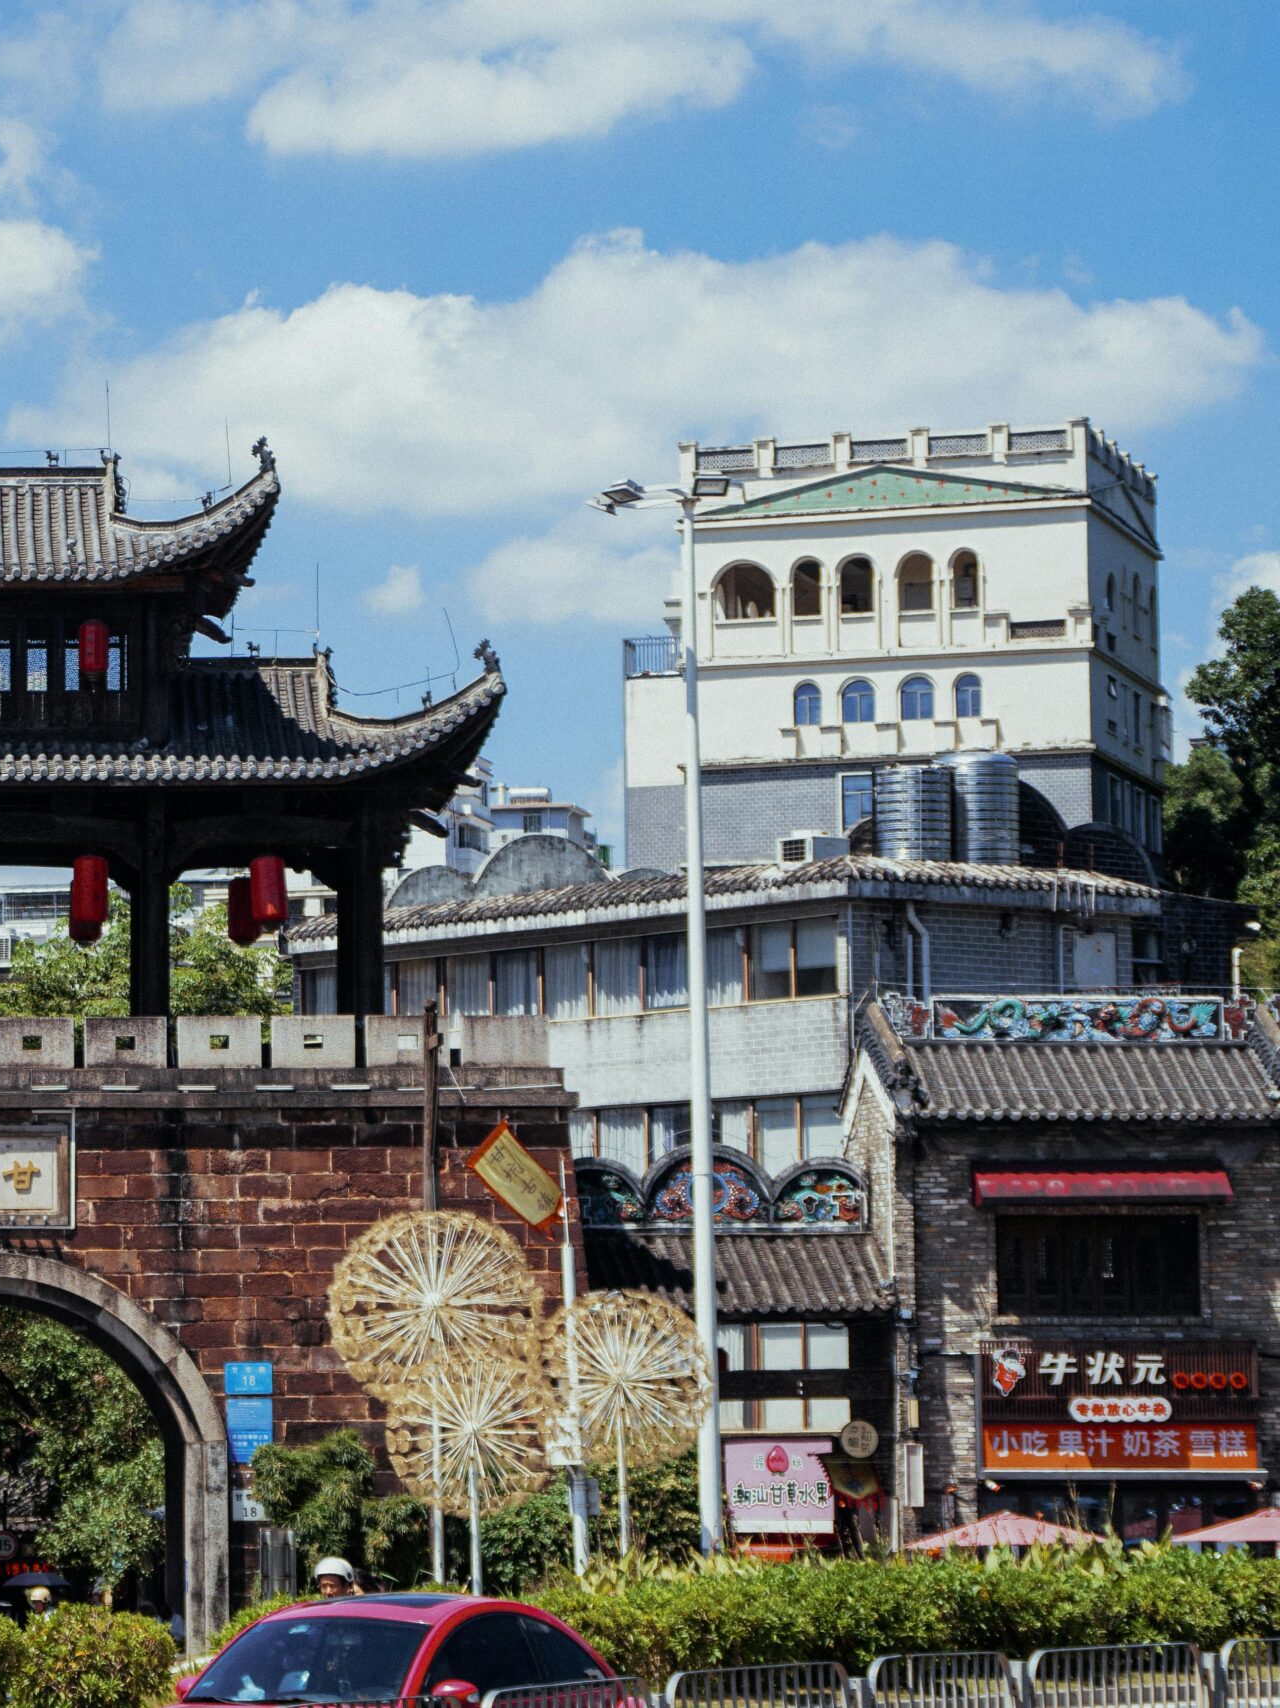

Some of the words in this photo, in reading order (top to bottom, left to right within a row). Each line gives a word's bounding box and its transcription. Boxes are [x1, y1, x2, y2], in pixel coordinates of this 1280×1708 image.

[241, 1375, 257, 1387] 18
[1038, 1351, 1168, 1386] 牛状元
[992, 1430, 1050, 1458] 小吃
[1057, 1430, 1115, 1458] 果汁
[1122, 1430, 1181, 1457] 奶茶
[1189, 1430, 1249, 1458] 雪糕
[731, 1481, 830, 1506] 潮汕甘草水果
[243, 1507, 257, 1518] 18
